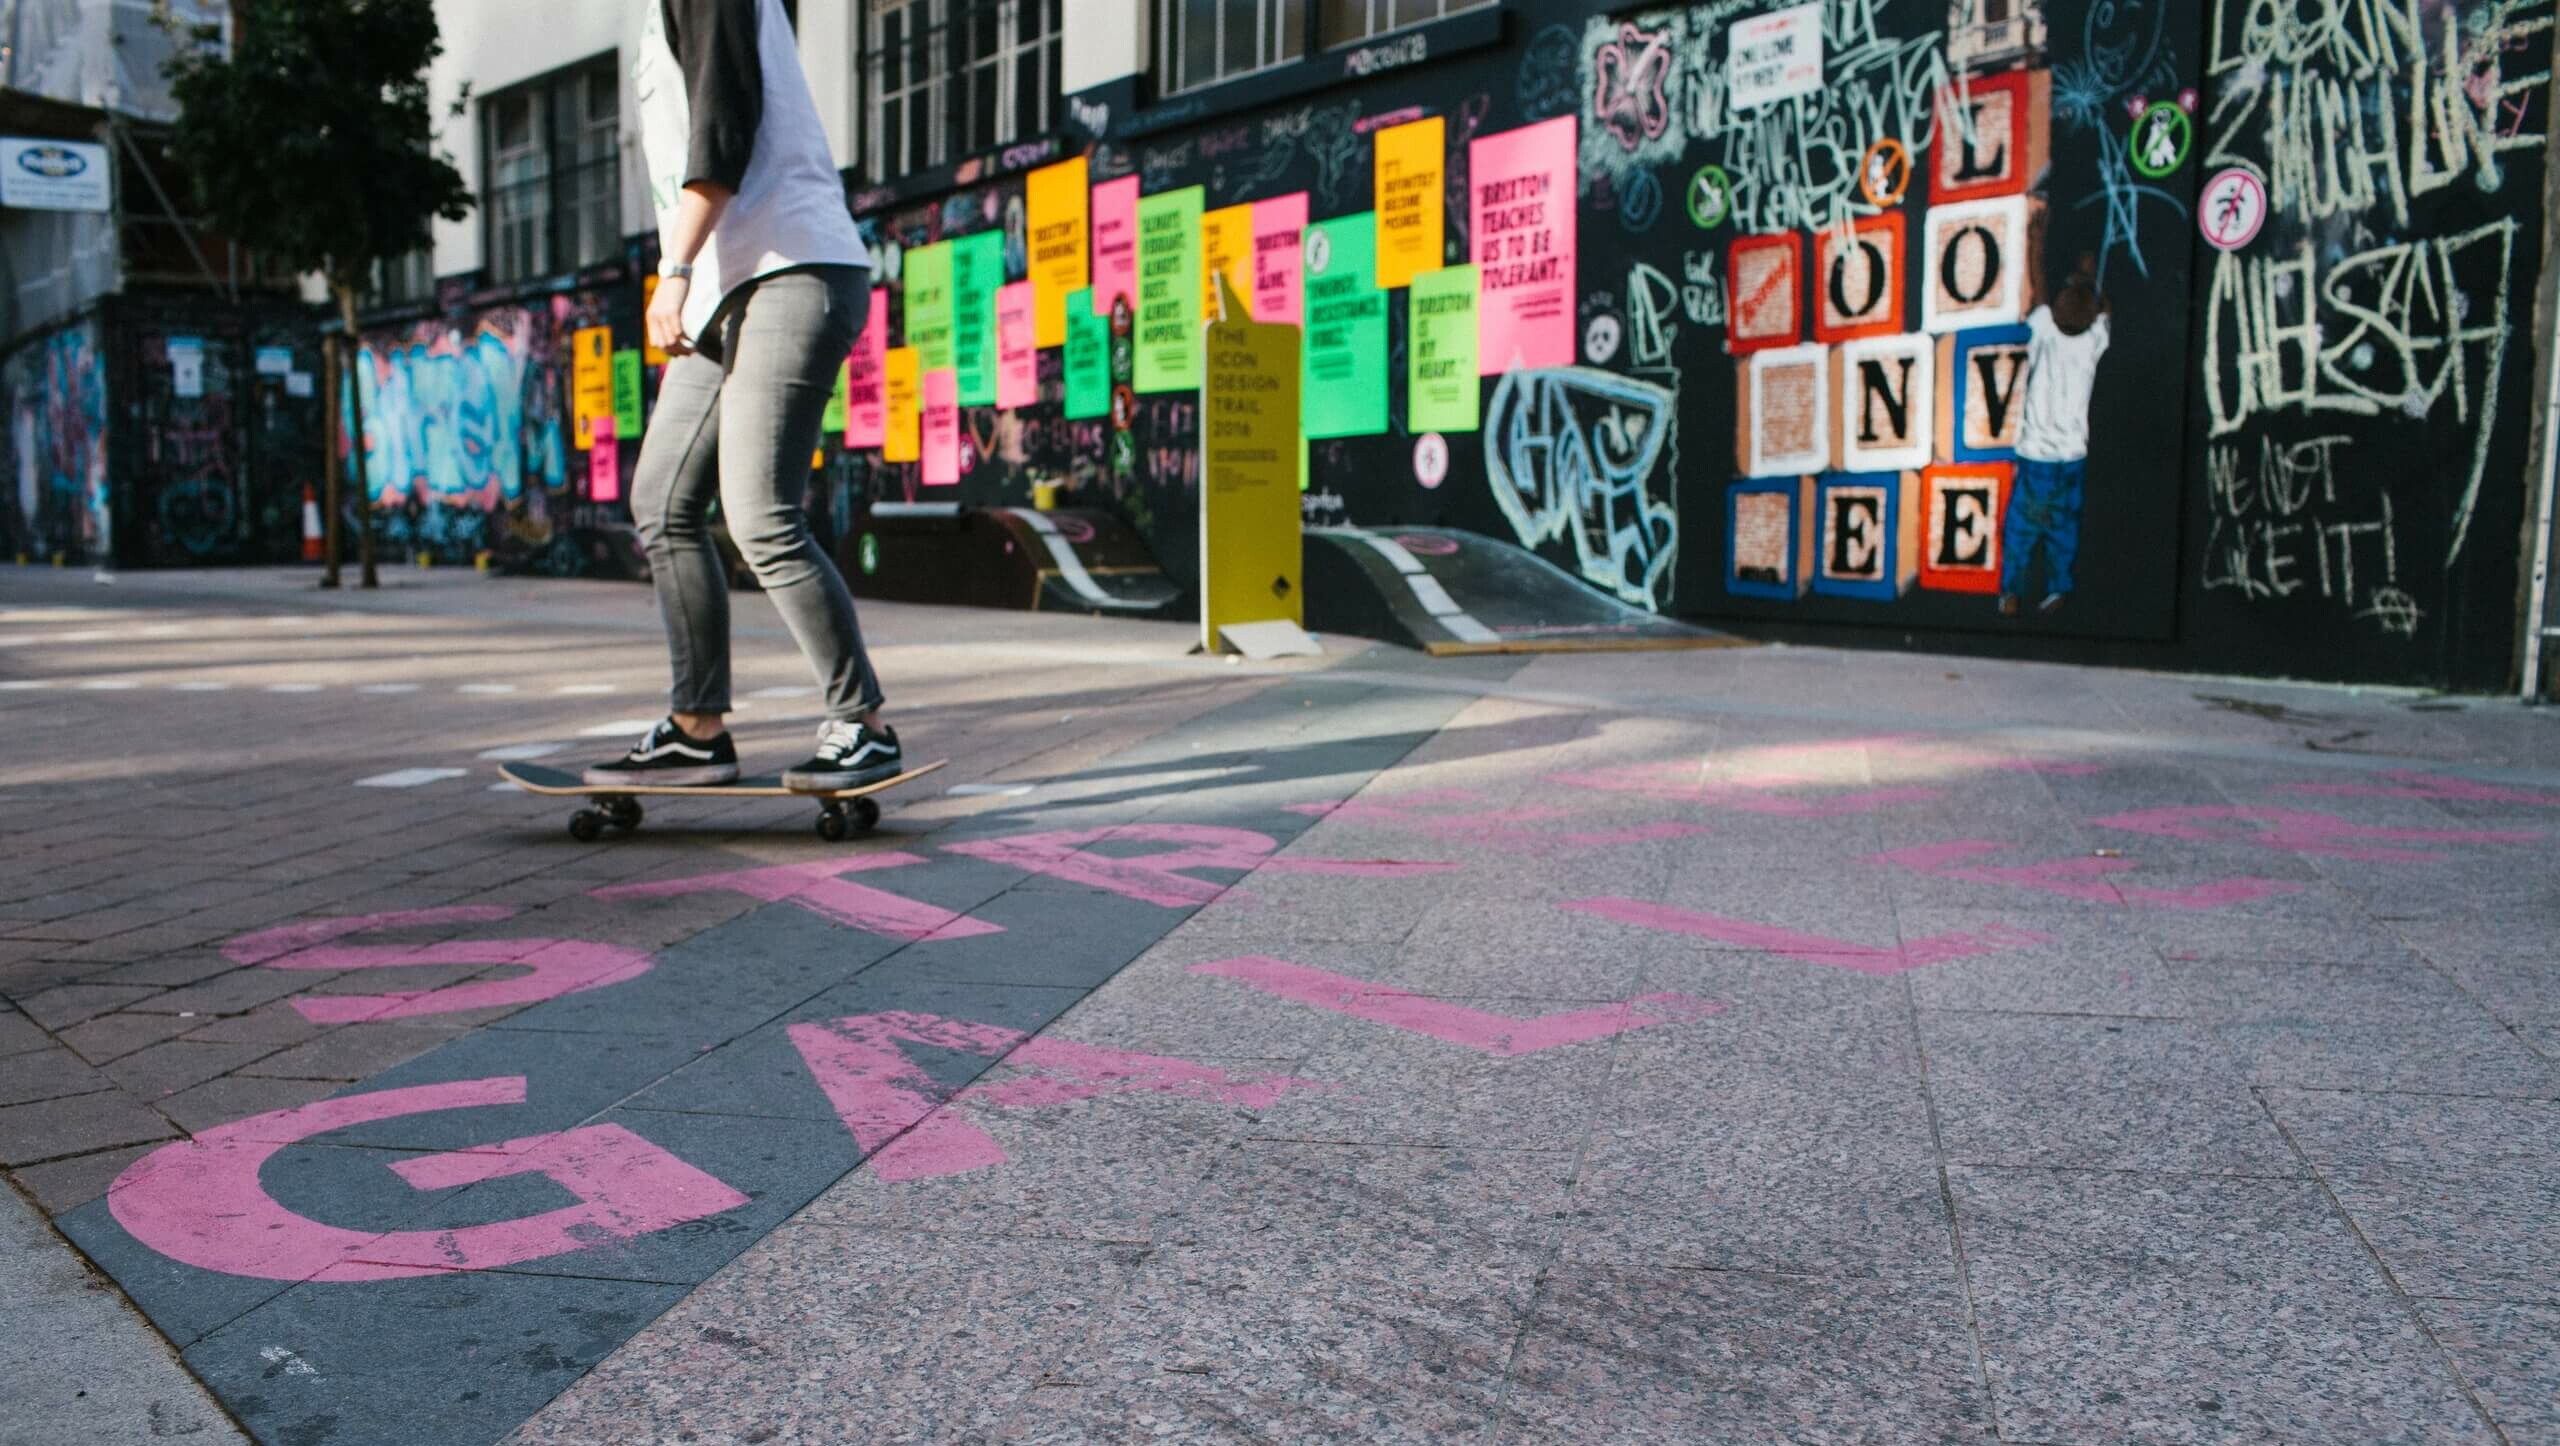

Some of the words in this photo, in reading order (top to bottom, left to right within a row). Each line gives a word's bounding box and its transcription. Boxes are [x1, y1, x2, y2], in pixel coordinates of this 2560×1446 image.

[1481, 201, 1545, 235] TEACHES
[1482, 238, 1500, 263] US
[1506, 233, 1525, 258] TO
[1531, 229, 1551, 254] BE
[1215, 327, 1246, 347] THE
[1214, 350, 1258, 369] ICON
[1214, 373, 1281, 392] DESIGN
[1214, 396, 1264, 415] TRAIL
[2260, 433, 2353, 516] NOT
[218, 733, 2105, 1024] STREET
[107, 770, 2560, 1283] GALLERY
